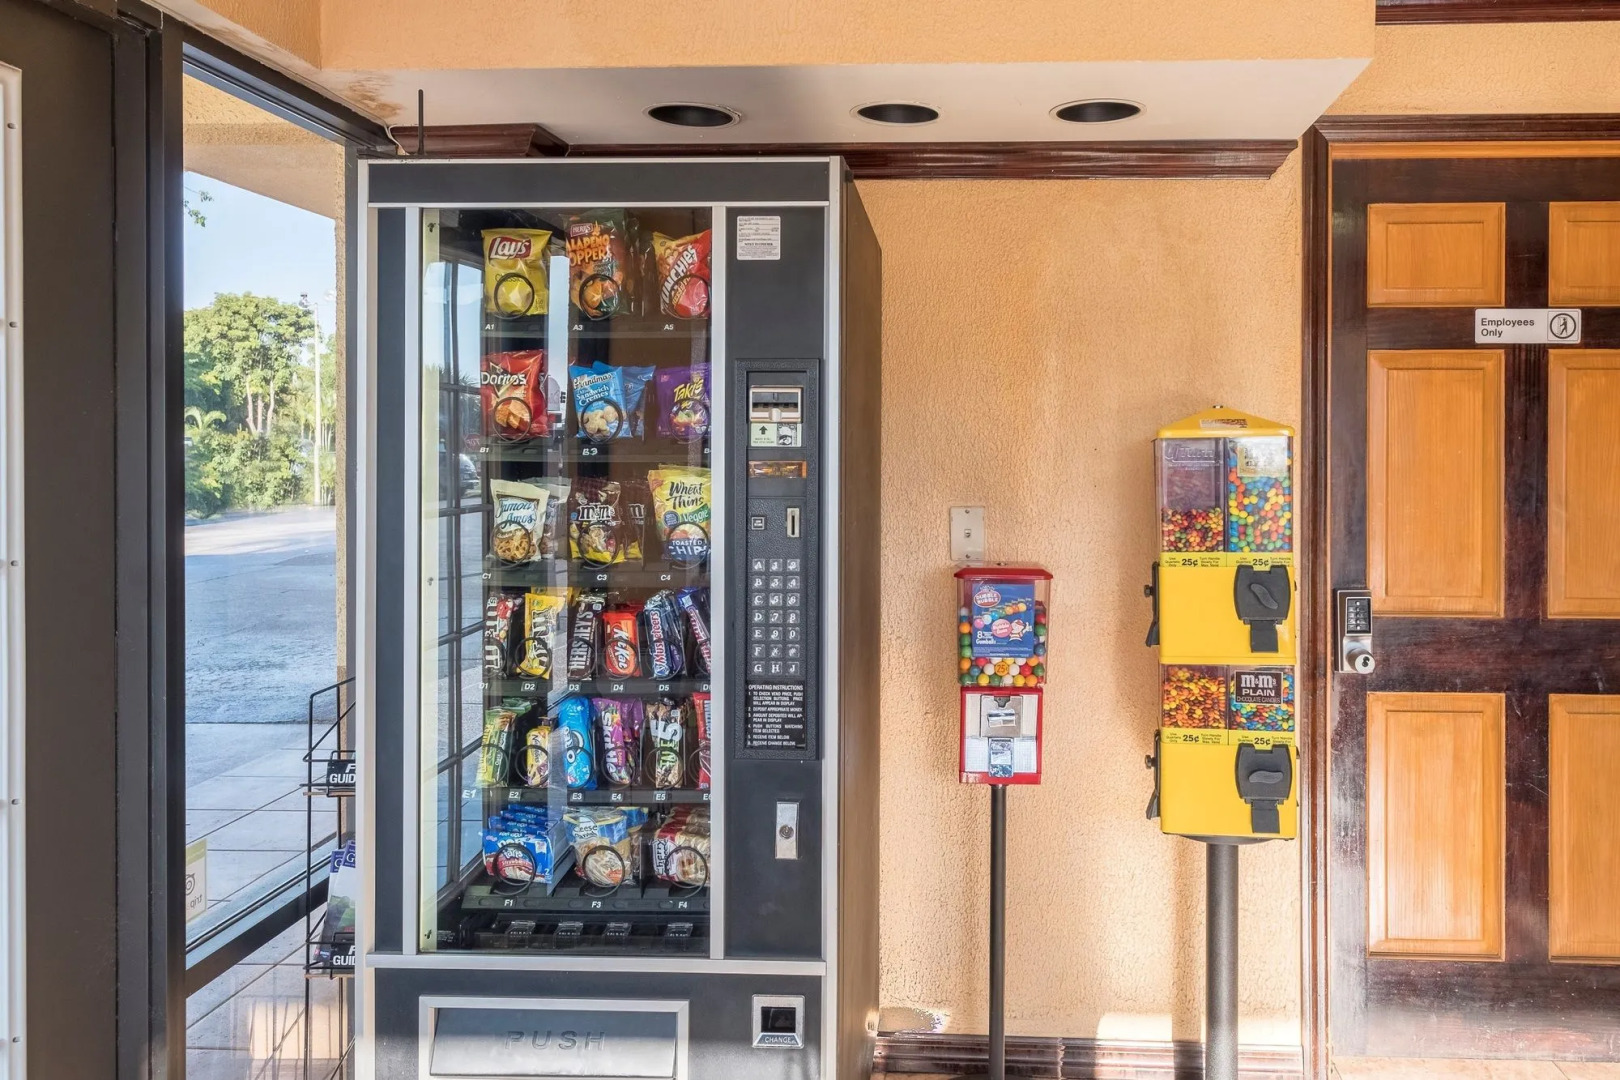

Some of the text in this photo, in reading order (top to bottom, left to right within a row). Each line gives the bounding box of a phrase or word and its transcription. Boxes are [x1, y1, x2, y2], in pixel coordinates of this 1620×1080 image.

[490, 238, 530, 260] Lay's
[1480, 318, 1535, 327] Employees
[1480, 328, 1503, 338] Only
[481, 372, 526, 385] Doritos
[576, 384, 610, 400] Sandwich
[674, 379, 704, 402] Takis
[669, 481, 704, 496] Wheat
[666, 495, 704, 510] Thins
[501, 512, 536, 530] Amos
[682, 508, 709, 523] Veggie
[1182, 559, 1198, 567] 25¢
[568, 612, 594, 670] HERSHEY'S
[650, 610, 668, 664] Museteers
[1242, 688, 1275, 696] PLAIN
[650, 720, 682, 741] 5
[1183, 734, 1199, 743] 25¢
[1254, 738, 1270, 746] 25¢
[330, 773, 356, 784] GUID
[462, 790, 476, 798] E1
[332, 956, 355, 966] GUID
[505, 1030, 605, 1050] PUSH
